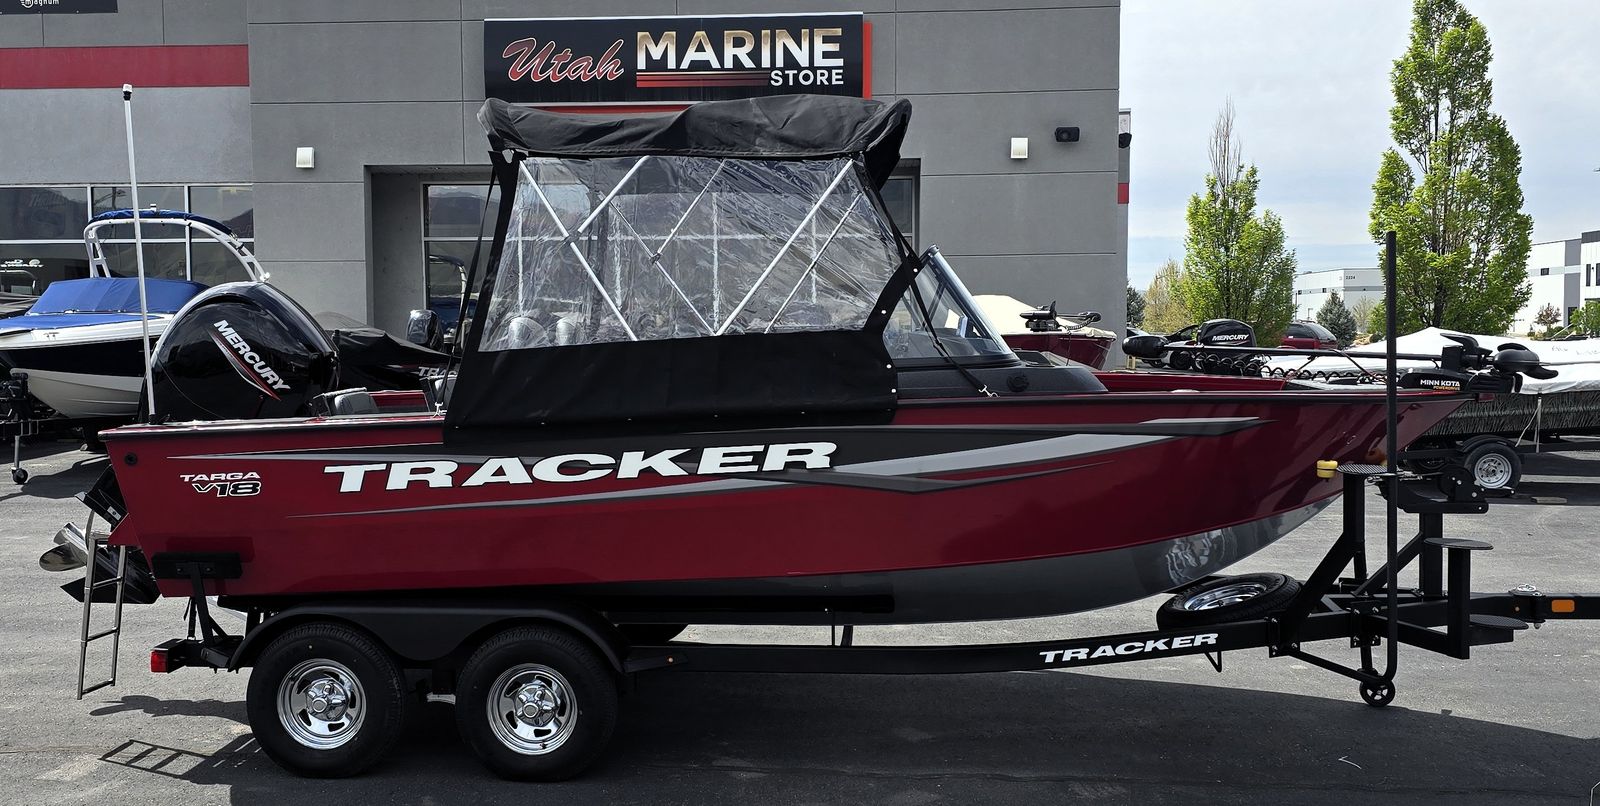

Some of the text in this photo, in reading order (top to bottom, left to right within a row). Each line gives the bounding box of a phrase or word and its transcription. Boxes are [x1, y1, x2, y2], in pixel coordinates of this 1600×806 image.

[502, 28, 845, 82] Utah MARINE
[770, 69, 844, 86] STORE
[1211, 333, 1250, 341] MERCURY
[213, 319, 291, 390] MERCURY
[180, 471, 261, 482] TARGA
[323, 441, 838, 493] TRACKER
[191, 480, 262, 498] V18
[1039, 633, 1219, 663] TRACKER
